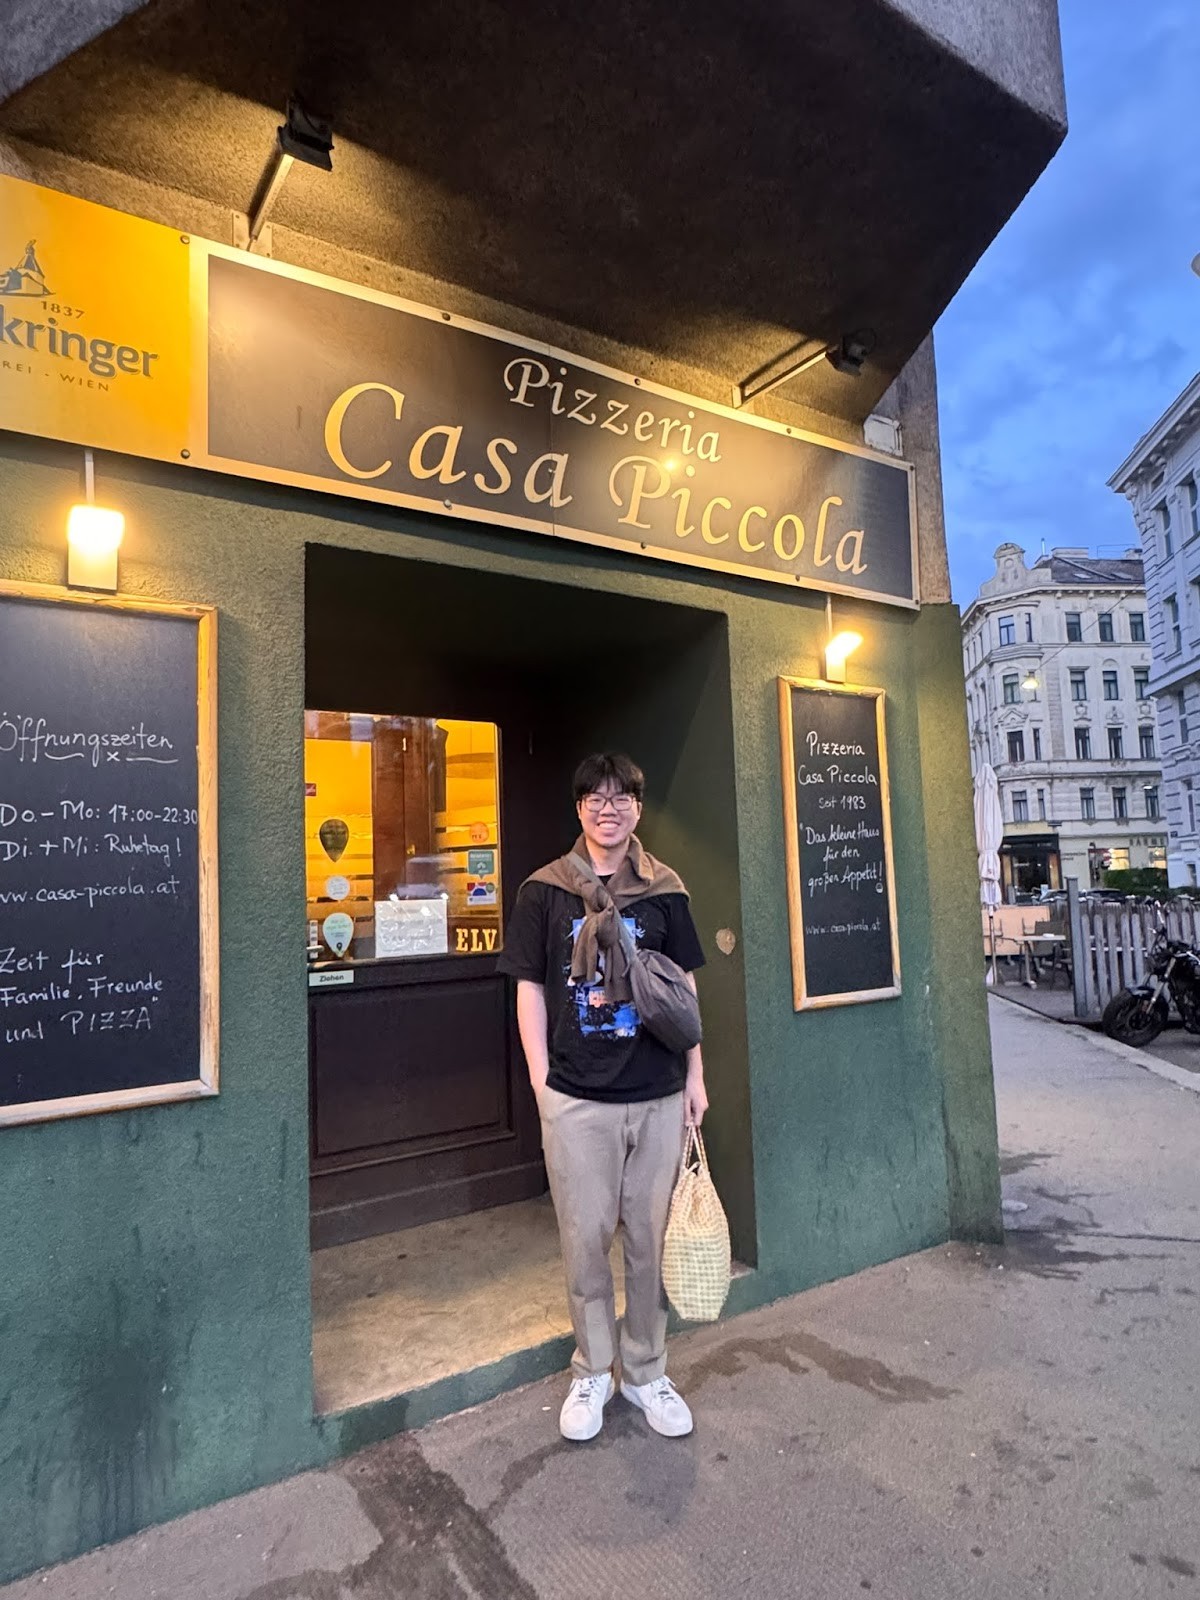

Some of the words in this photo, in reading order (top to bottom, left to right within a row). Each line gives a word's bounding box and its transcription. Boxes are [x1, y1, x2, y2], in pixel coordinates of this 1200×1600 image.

[41, 301, 85, 319] 1837
[60, 373, 109, 391] WIEN
[504, 357, 722, 463] Pizzeria
[324, 382, 573, 508] Casa
[609, 455, 868, 575] Piccola
[0, 712, 173, 768] Öffnungszeiten
[806, 731, 866, 757] Pizzeria
[798, 765, 824, 785] Casa
[826, 765, 877, 786] Piccola
[841, 795, 866, 810] 1983
[828, 824, 855, 842] kleine
[857, 821, 880, 839] Haus
[823, 845, 839, 871] für
[841, 845, 860, 858] den
[808, 872, 839, 898] großen
[456, 928, 497, 952] ELV
[0, 947, 49, 974] Zeit
[61, 949, 104, 984] für
[87, 972, 163, 998] Freunde
[6, 1021, 43, 1043] und
